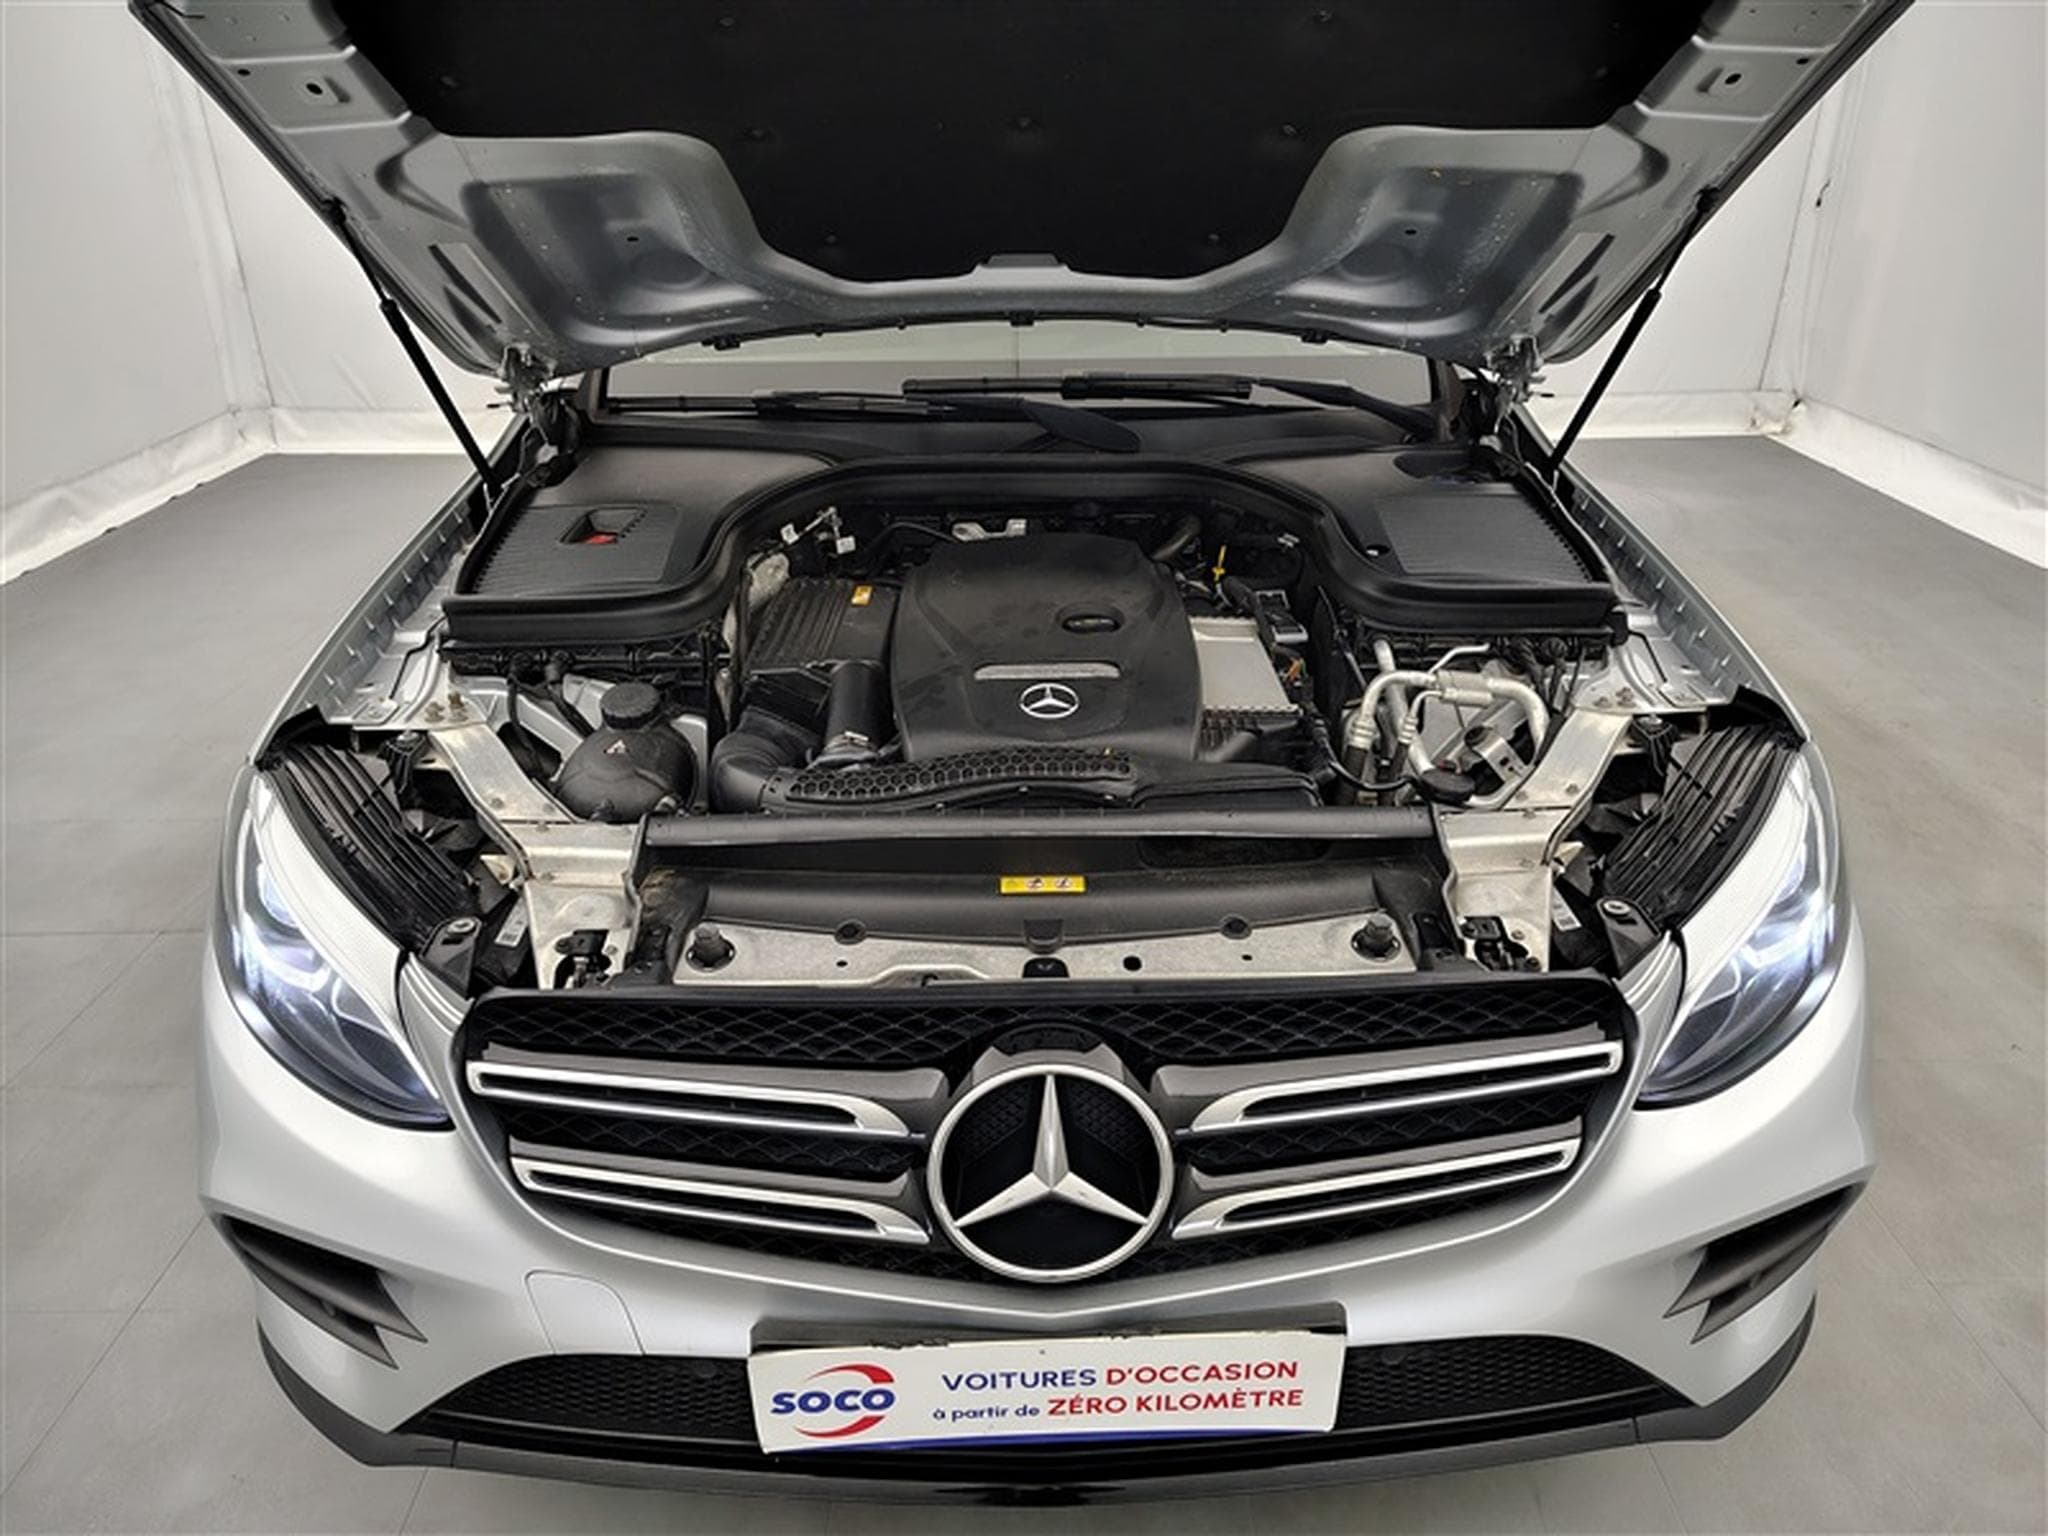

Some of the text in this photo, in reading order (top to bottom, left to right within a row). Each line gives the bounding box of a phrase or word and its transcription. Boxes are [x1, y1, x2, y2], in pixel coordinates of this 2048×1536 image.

[941, 1361, 1298, 1391] VOITURES D'OCCASION
[771, 1388, 895, 1414] SOCO
[933, 1388, 1304, 1424] à partir de ZÉRO KILOMÈTRE
